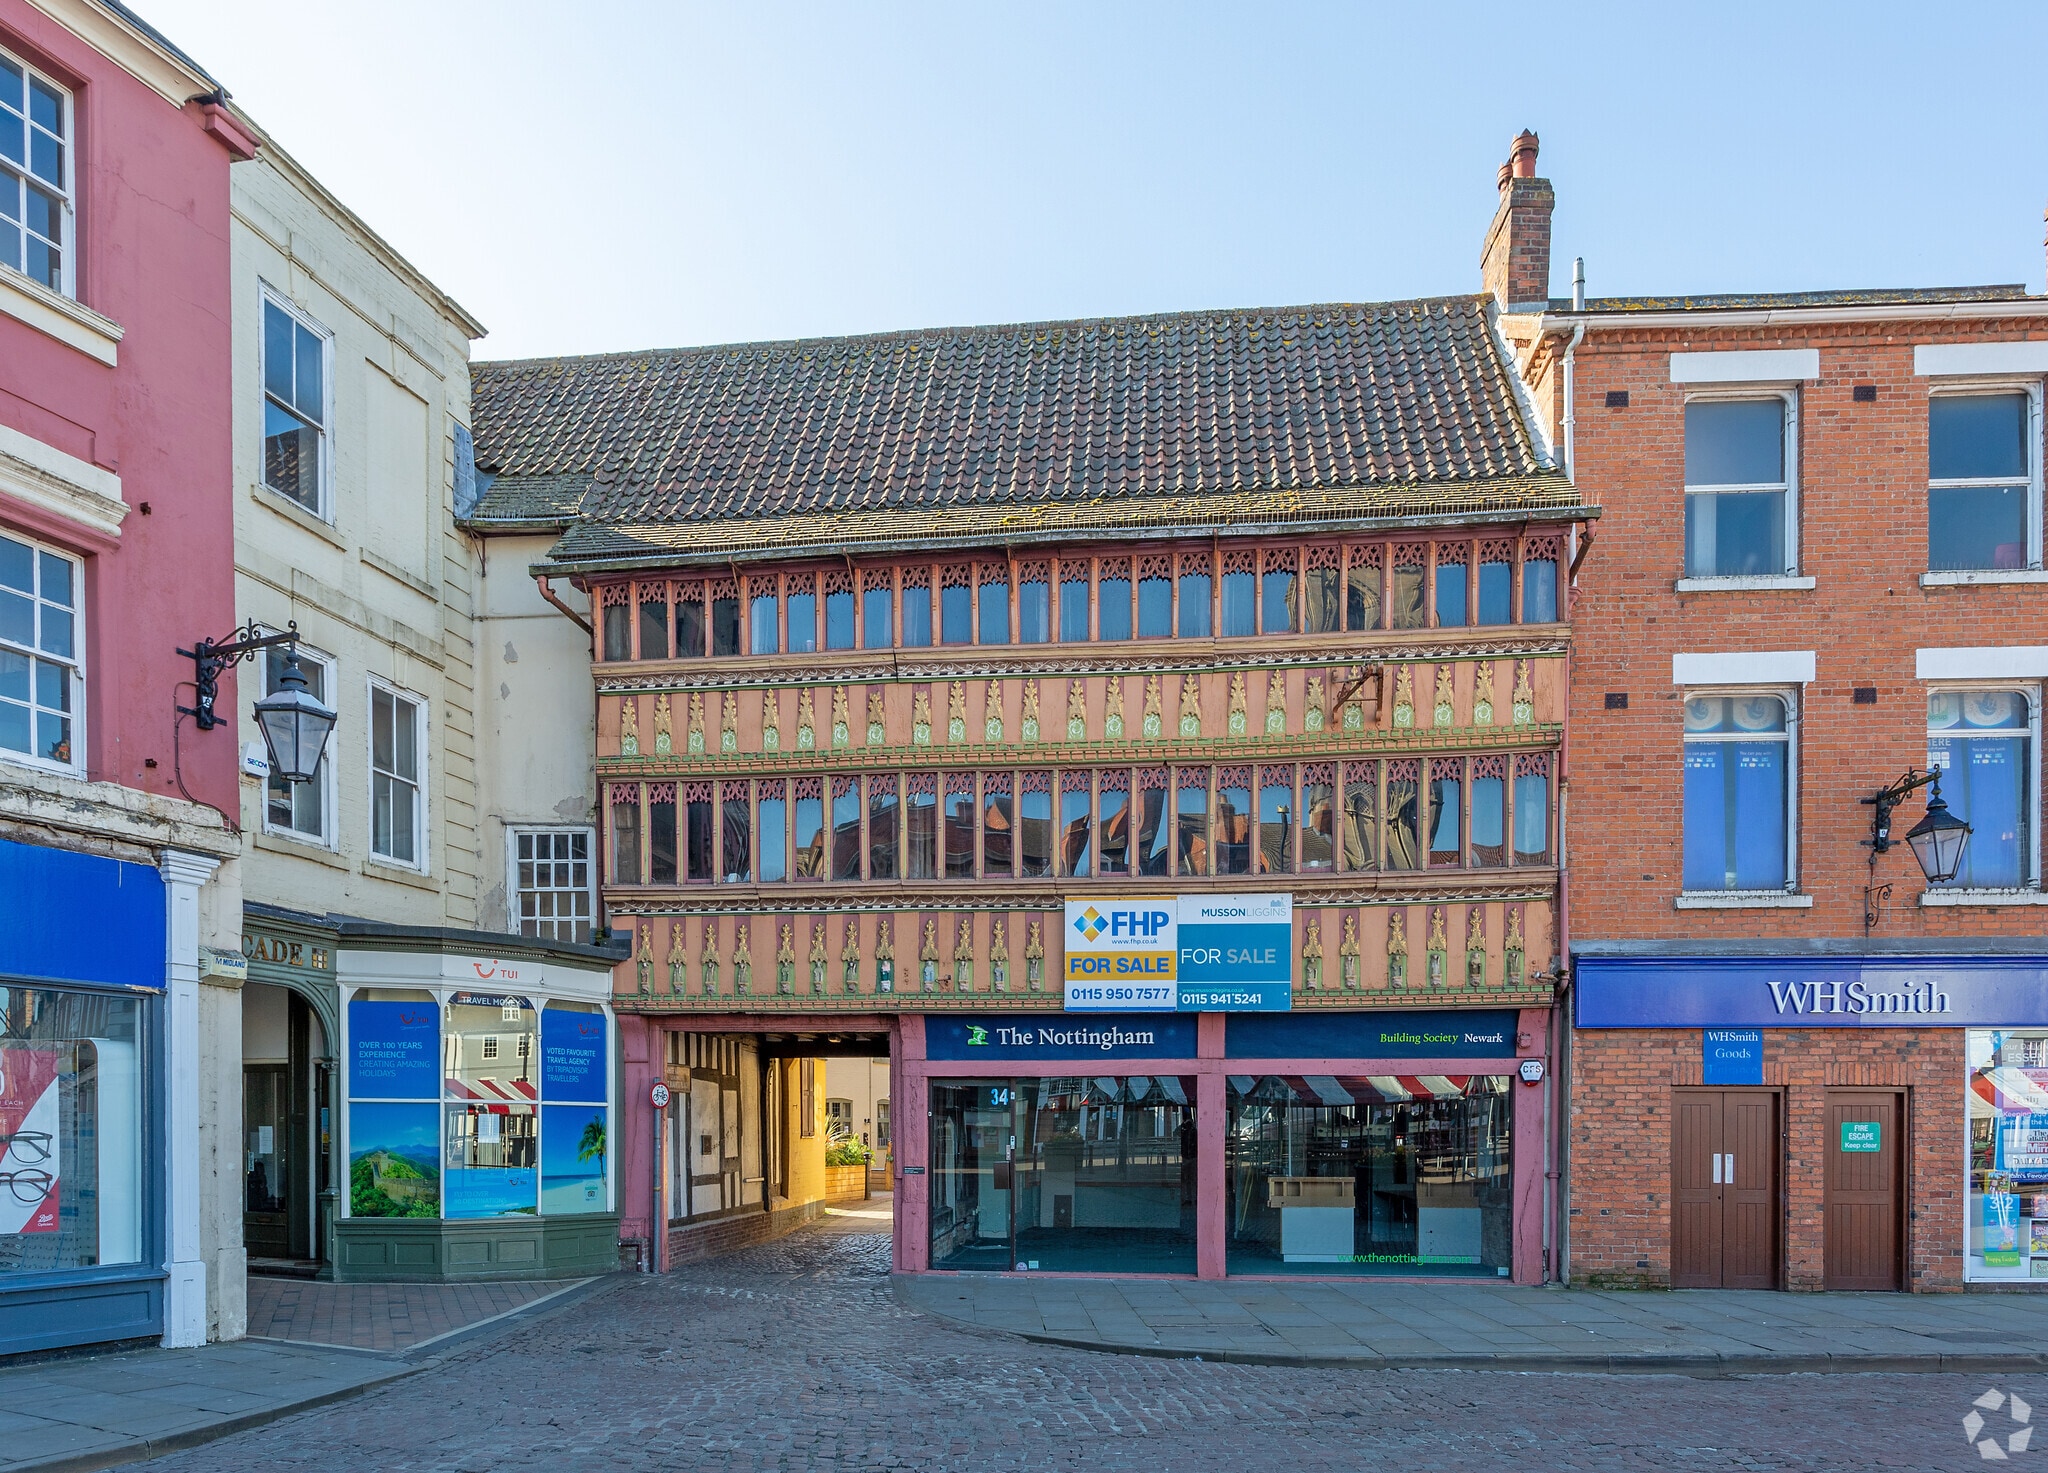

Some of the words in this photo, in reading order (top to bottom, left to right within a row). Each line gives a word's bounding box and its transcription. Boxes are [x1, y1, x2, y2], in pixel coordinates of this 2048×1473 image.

[1111, 911, 1170, 937] FHP
[1181, 948, 1221, 965] FOR
[1226, 948, 1277, 964] SALE
[1070, 957, 1111, 974] FOR
[1116, 957, 1170, 974] SALE
[500, 969, 518, 979] TUI
[1071, 988, 1102, 1000] 0115
[1105, 988, 1134, 1000] 950
[1136, 987, 1170, 1000] 7577
[1181, 993, 1208, 1005] 0115
[1210, 993, 1231, 1005] 941
[1233, 993, 1262, 1005] 5241
[1767, 980, 1953, 1014] WHSmith
[462, 996, 492, 1007] TRAVEL
[996, 1027, 1034, 1046] The
[1038, 1026, 1155, 1051] Nottingham
[1379, 1033, 1421, 1045] Building
[1423, 1033, 1459, 1045] Society
[1463, 1032, 1503, 1044] Newark
[1708, 1031, 1759, 1042] WHSmith
[358, 1041, 380, 1049] OVER
[397, 1042, 423, 1050] YEARS
[359, 1050, 406, 1059] EXPERIENCE
[546, 1047, 566, 1056] VOTED
[567, 1048, 596, 1058] FAVOURITE
[1715, 1048, 1752, 1059] Goods
[359, 1060, 395, 1068] CREATING
[397, 1060, 431, 1069] AMAZING
[547, 1056, 567, 1065] TRAVEL
[568, 1057, 591, 1066] AGENCY
[359, 1069, 397, 1078] HOLIDAYS
[555, 1065, 589, 1075] TRIPADVISOR
[1522, 1065, 1542, 1074] CFS
[547, 1074, 580, 1083] TRAVELLERS
[990, 1088, 1009, 1106] 34
[1854, 1124, 1869, 1132] FIRE
[1848, 1132, 1874, 1141] ESCAPE
[1336, 1253, 1473, 1266] www.thenottingham.com
